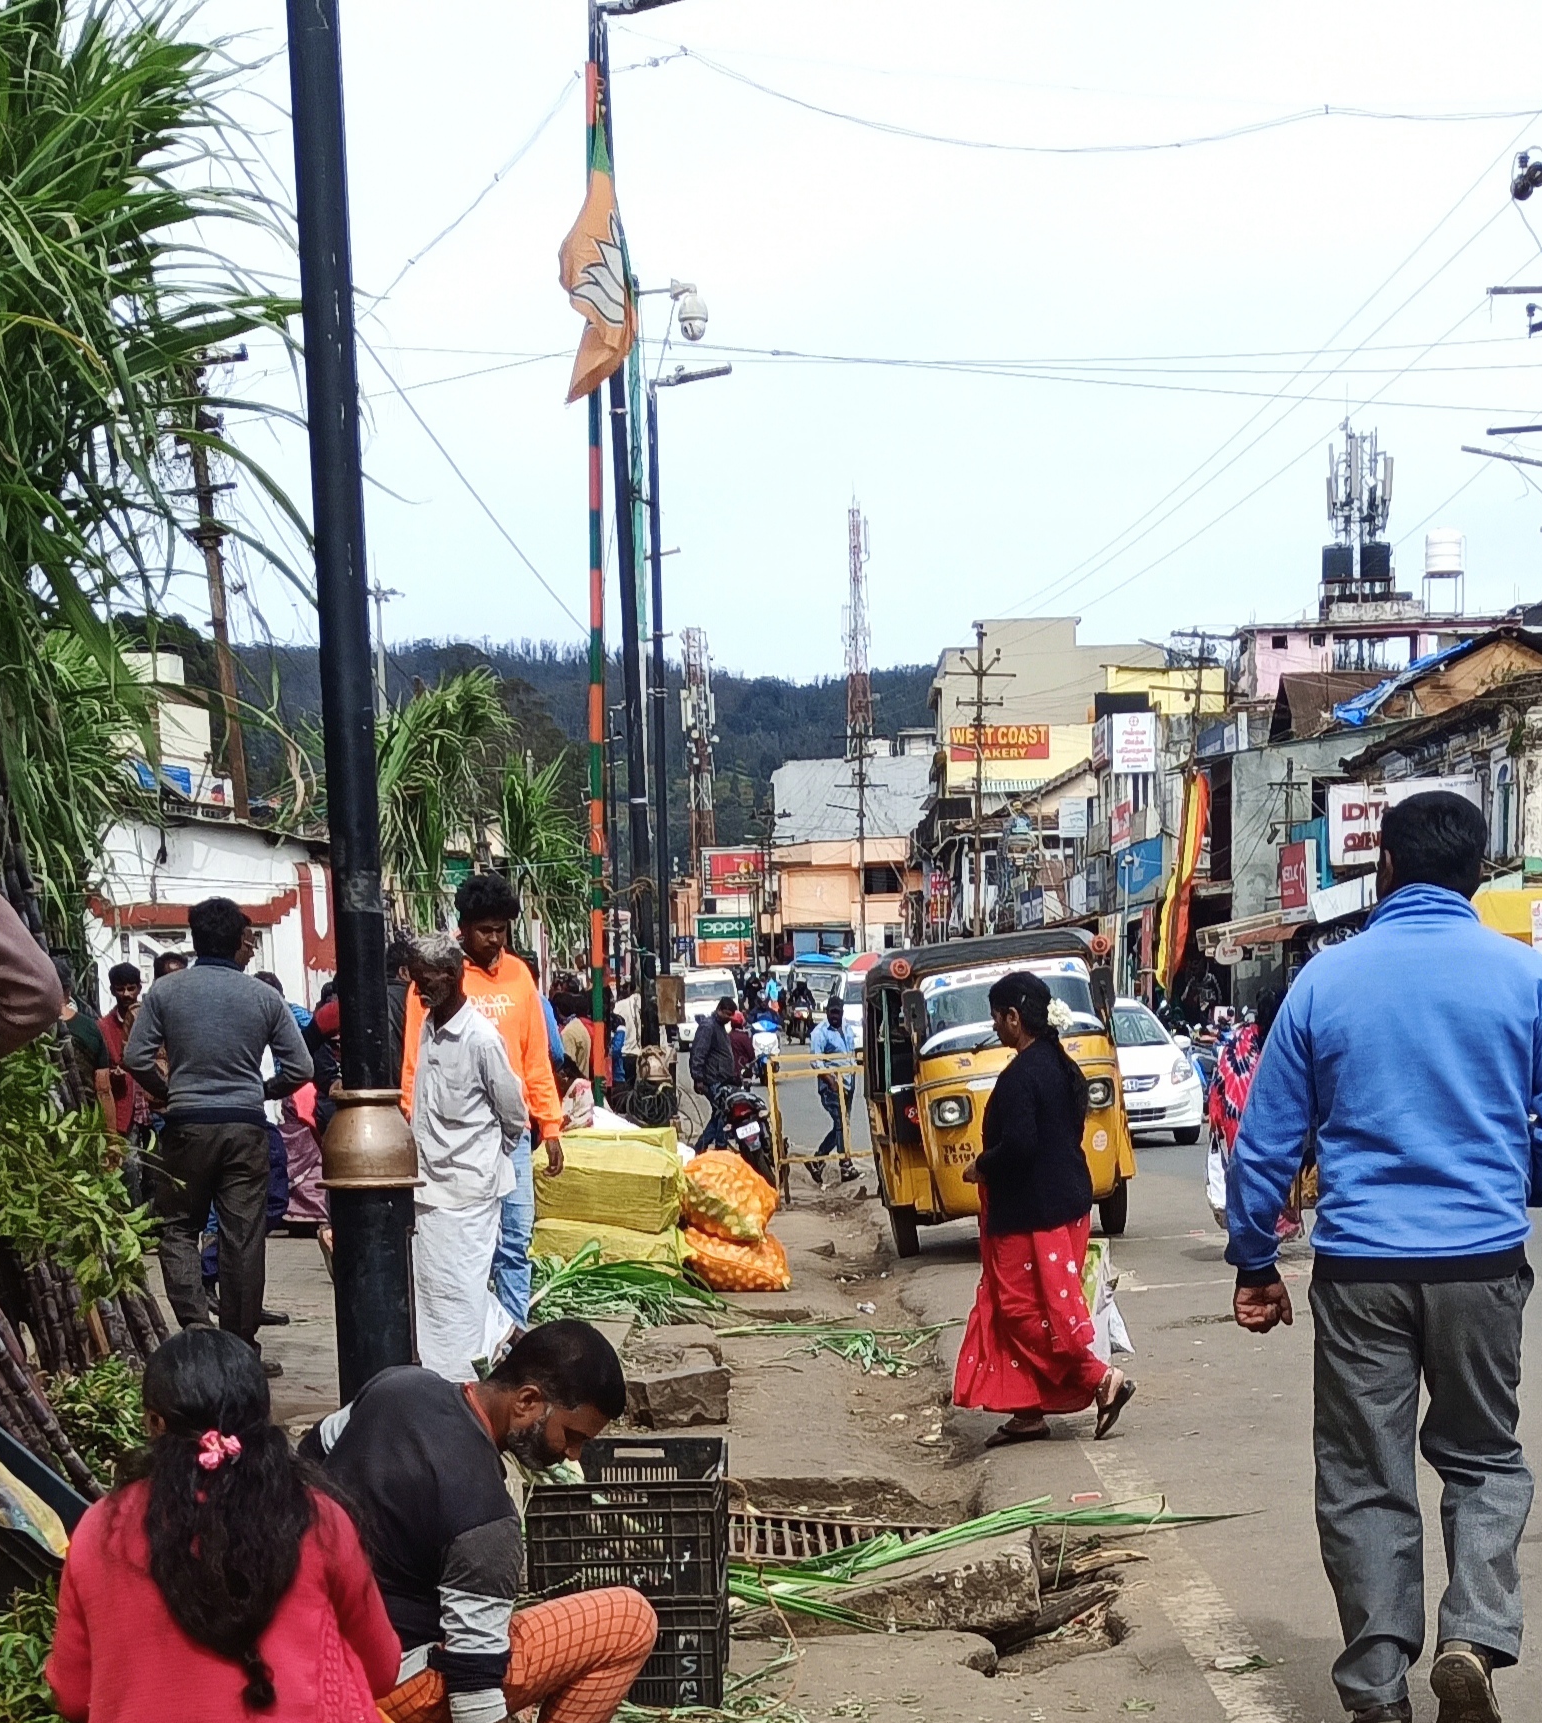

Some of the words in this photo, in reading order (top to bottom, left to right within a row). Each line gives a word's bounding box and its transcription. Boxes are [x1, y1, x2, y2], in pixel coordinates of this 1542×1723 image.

[997, 726, 1049, 744] COAST
[974, 747, 1028, 758] AKERY
[702, 921, 746, 934] oppo
